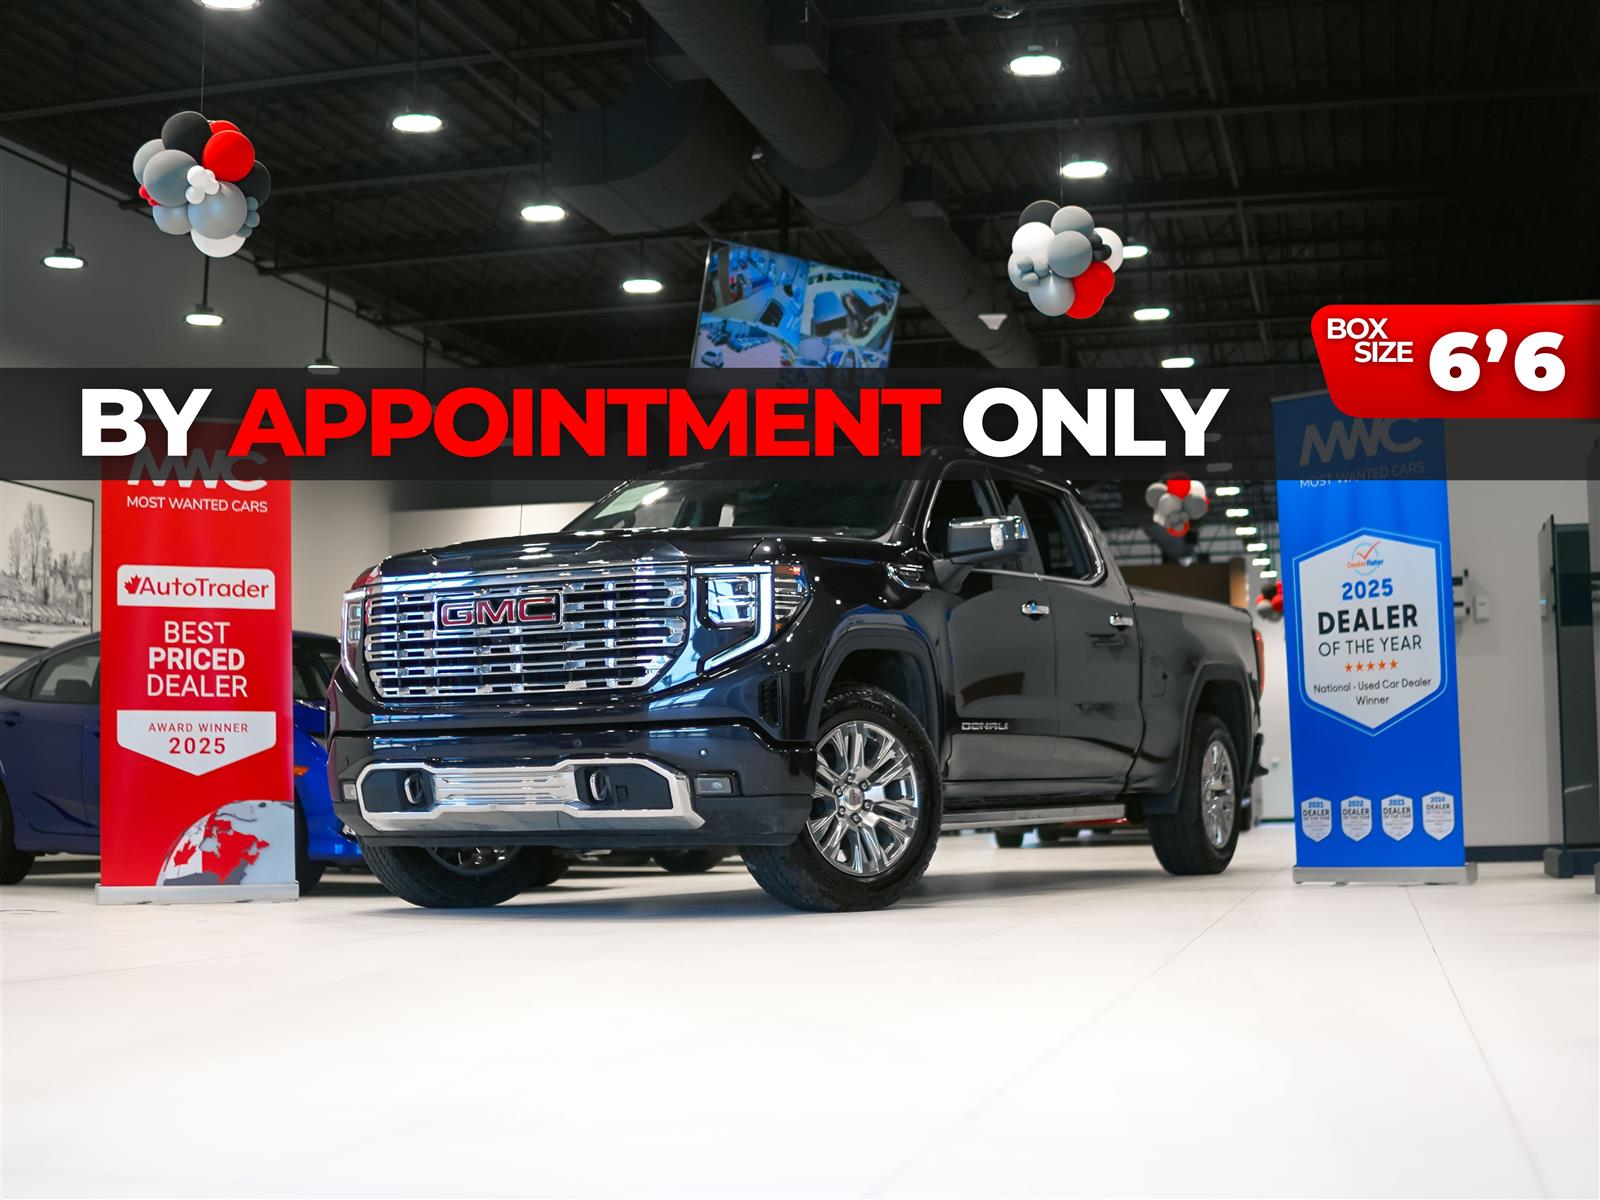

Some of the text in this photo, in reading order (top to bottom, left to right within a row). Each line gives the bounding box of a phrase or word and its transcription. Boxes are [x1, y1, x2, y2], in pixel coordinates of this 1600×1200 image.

[1300, 473, 1333, 489] MOST
[127, 496, 268, 513] MOST WANTED CARS
[139, 576, 269, 599] AutoTrader
[1341, 578, 1394, 601] 2025
[440, 595, 558, 628] GMC
[1317, 604, 1419, 636] DEALER
[164, 620, 231, 645] BEST
[1318, 634, 1422, 658] OF THE YEAR
[148, 646, 246, 671] PRICED
[147, 673, 249, 698] DEALER
[1313, 682, 1351, 694] National
[1358, 680, 1381, 691] Used
[1382, 679, 1400, 689] Car
[1401, 677, 1432, 688] Dealer
[1355, 695, 1389, 706] Winner
[148, 722, 249, 733] AWARD WINNER
[961, 722, 1009, 731] DENALI
[168, 737, 226, 755] 2025
[1303, 809, 1330, 817] DEALER
[1342, 808, 1370, 816] DEALER
